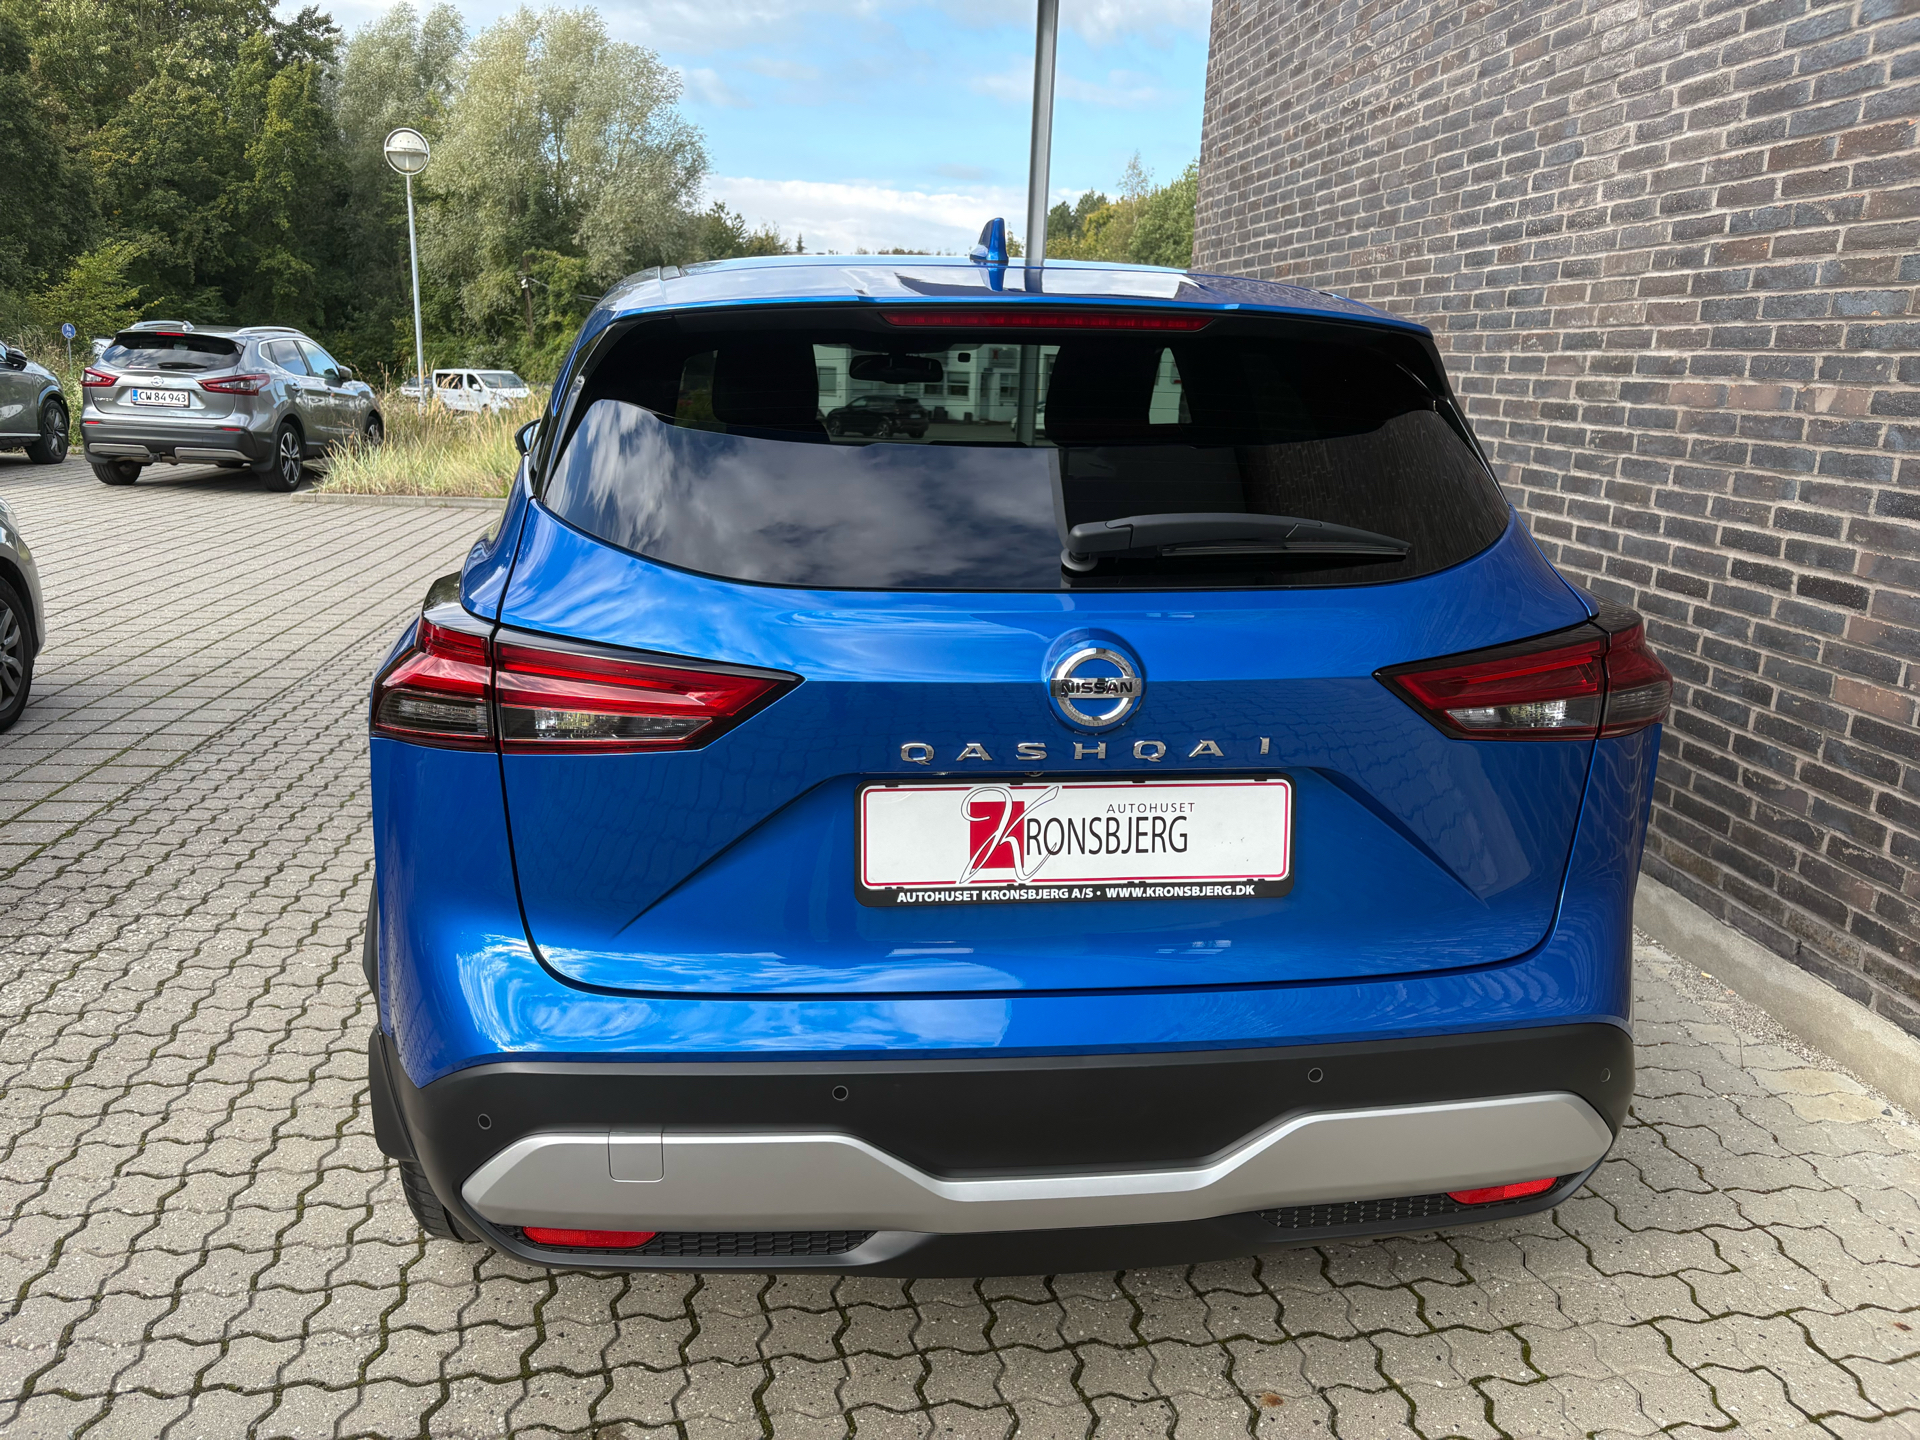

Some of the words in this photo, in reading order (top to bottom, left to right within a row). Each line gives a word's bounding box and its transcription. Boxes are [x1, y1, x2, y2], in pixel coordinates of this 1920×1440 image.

[139, 391, 152, 401] CW
[154, 392, 167, 402] 84
[169, 393, 187, 403] 943
[1060, 681, 1133, 694] NISSAN
[899, 736, 1271, 766] QASHQAI
[1106, 802, 1196, 814] AUTOHUSET
[959, 785, 1189, 884] KRONSBJERG
[896, 890, 980, 903] AUTOHUSET
[981, 888, 1069, 901] KRONSBJERG
[1071, 887, 1094, 899] A/S
[1105, 884, 1256, 898] WWW.KRONSBJERG.DK
